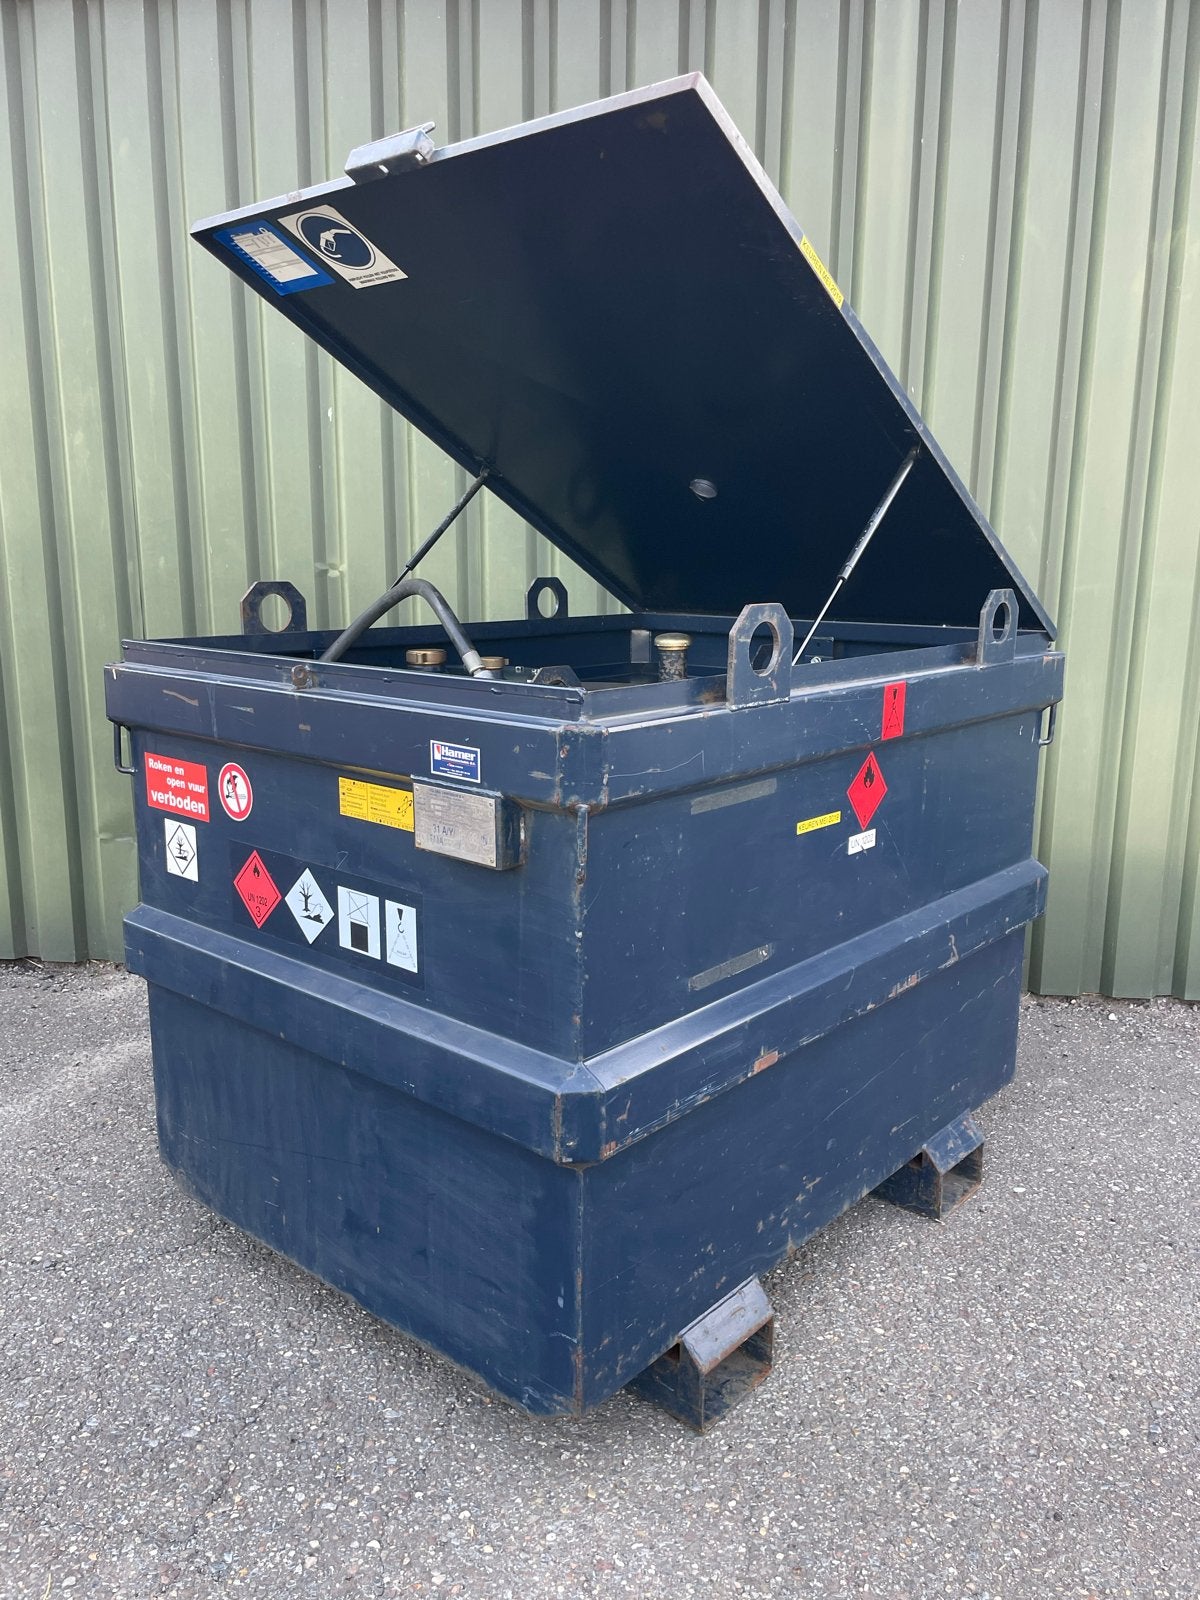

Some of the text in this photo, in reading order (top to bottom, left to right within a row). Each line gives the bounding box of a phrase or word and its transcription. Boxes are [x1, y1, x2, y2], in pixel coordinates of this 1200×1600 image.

[441, 745, 476, 761] Hamer
[148, 758, 184, 776] Roken en
[166, 777, 205, 794] open vuur
[151, 789, 206, 815] verboden
[247, 892, 255, 902] UN
[255, 905, 261, 917] 3
